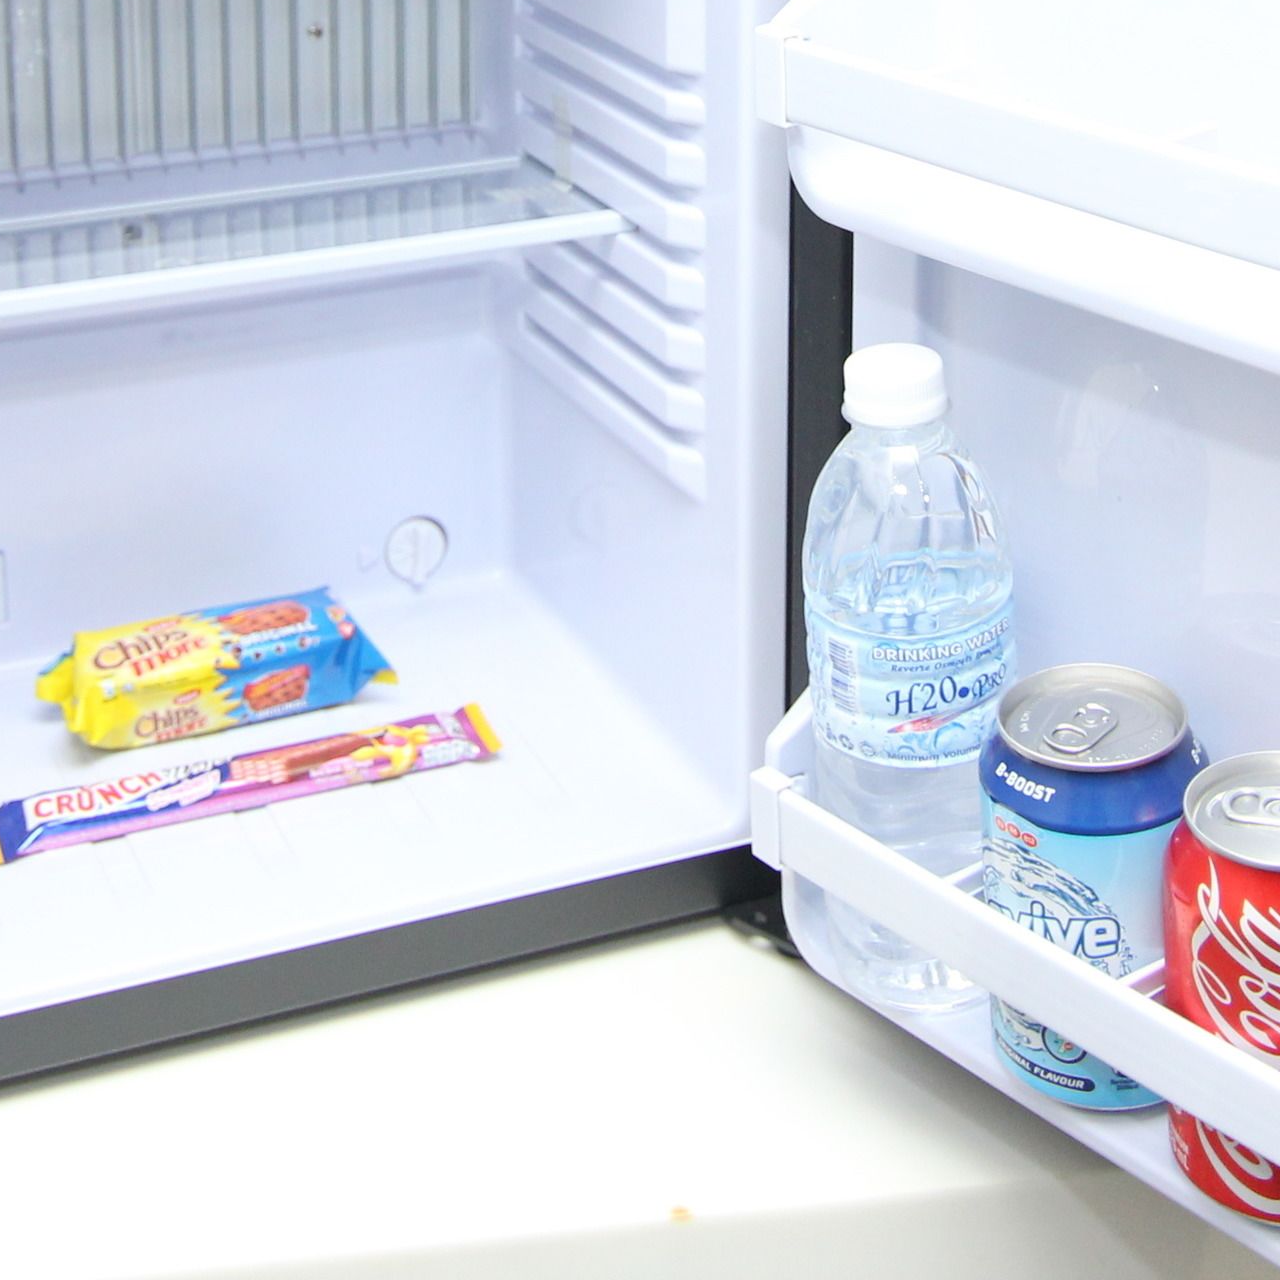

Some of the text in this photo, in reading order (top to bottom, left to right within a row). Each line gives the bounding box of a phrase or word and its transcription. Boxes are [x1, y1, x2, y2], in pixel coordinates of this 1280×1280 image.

[94, 629, 187, 670] Chips
[130, 637, 209, 676] more
[872, 642, 962, 663] DRINKING
[967, 618, 1008, 650] WATER
[135, 706, 199, 737] Chips
[34, 769, 161, 819] CRUNCH
[995, 761, 1056, 803] B-BOOST
[1033, 1066, 1085, 1089] FLAVOUR
